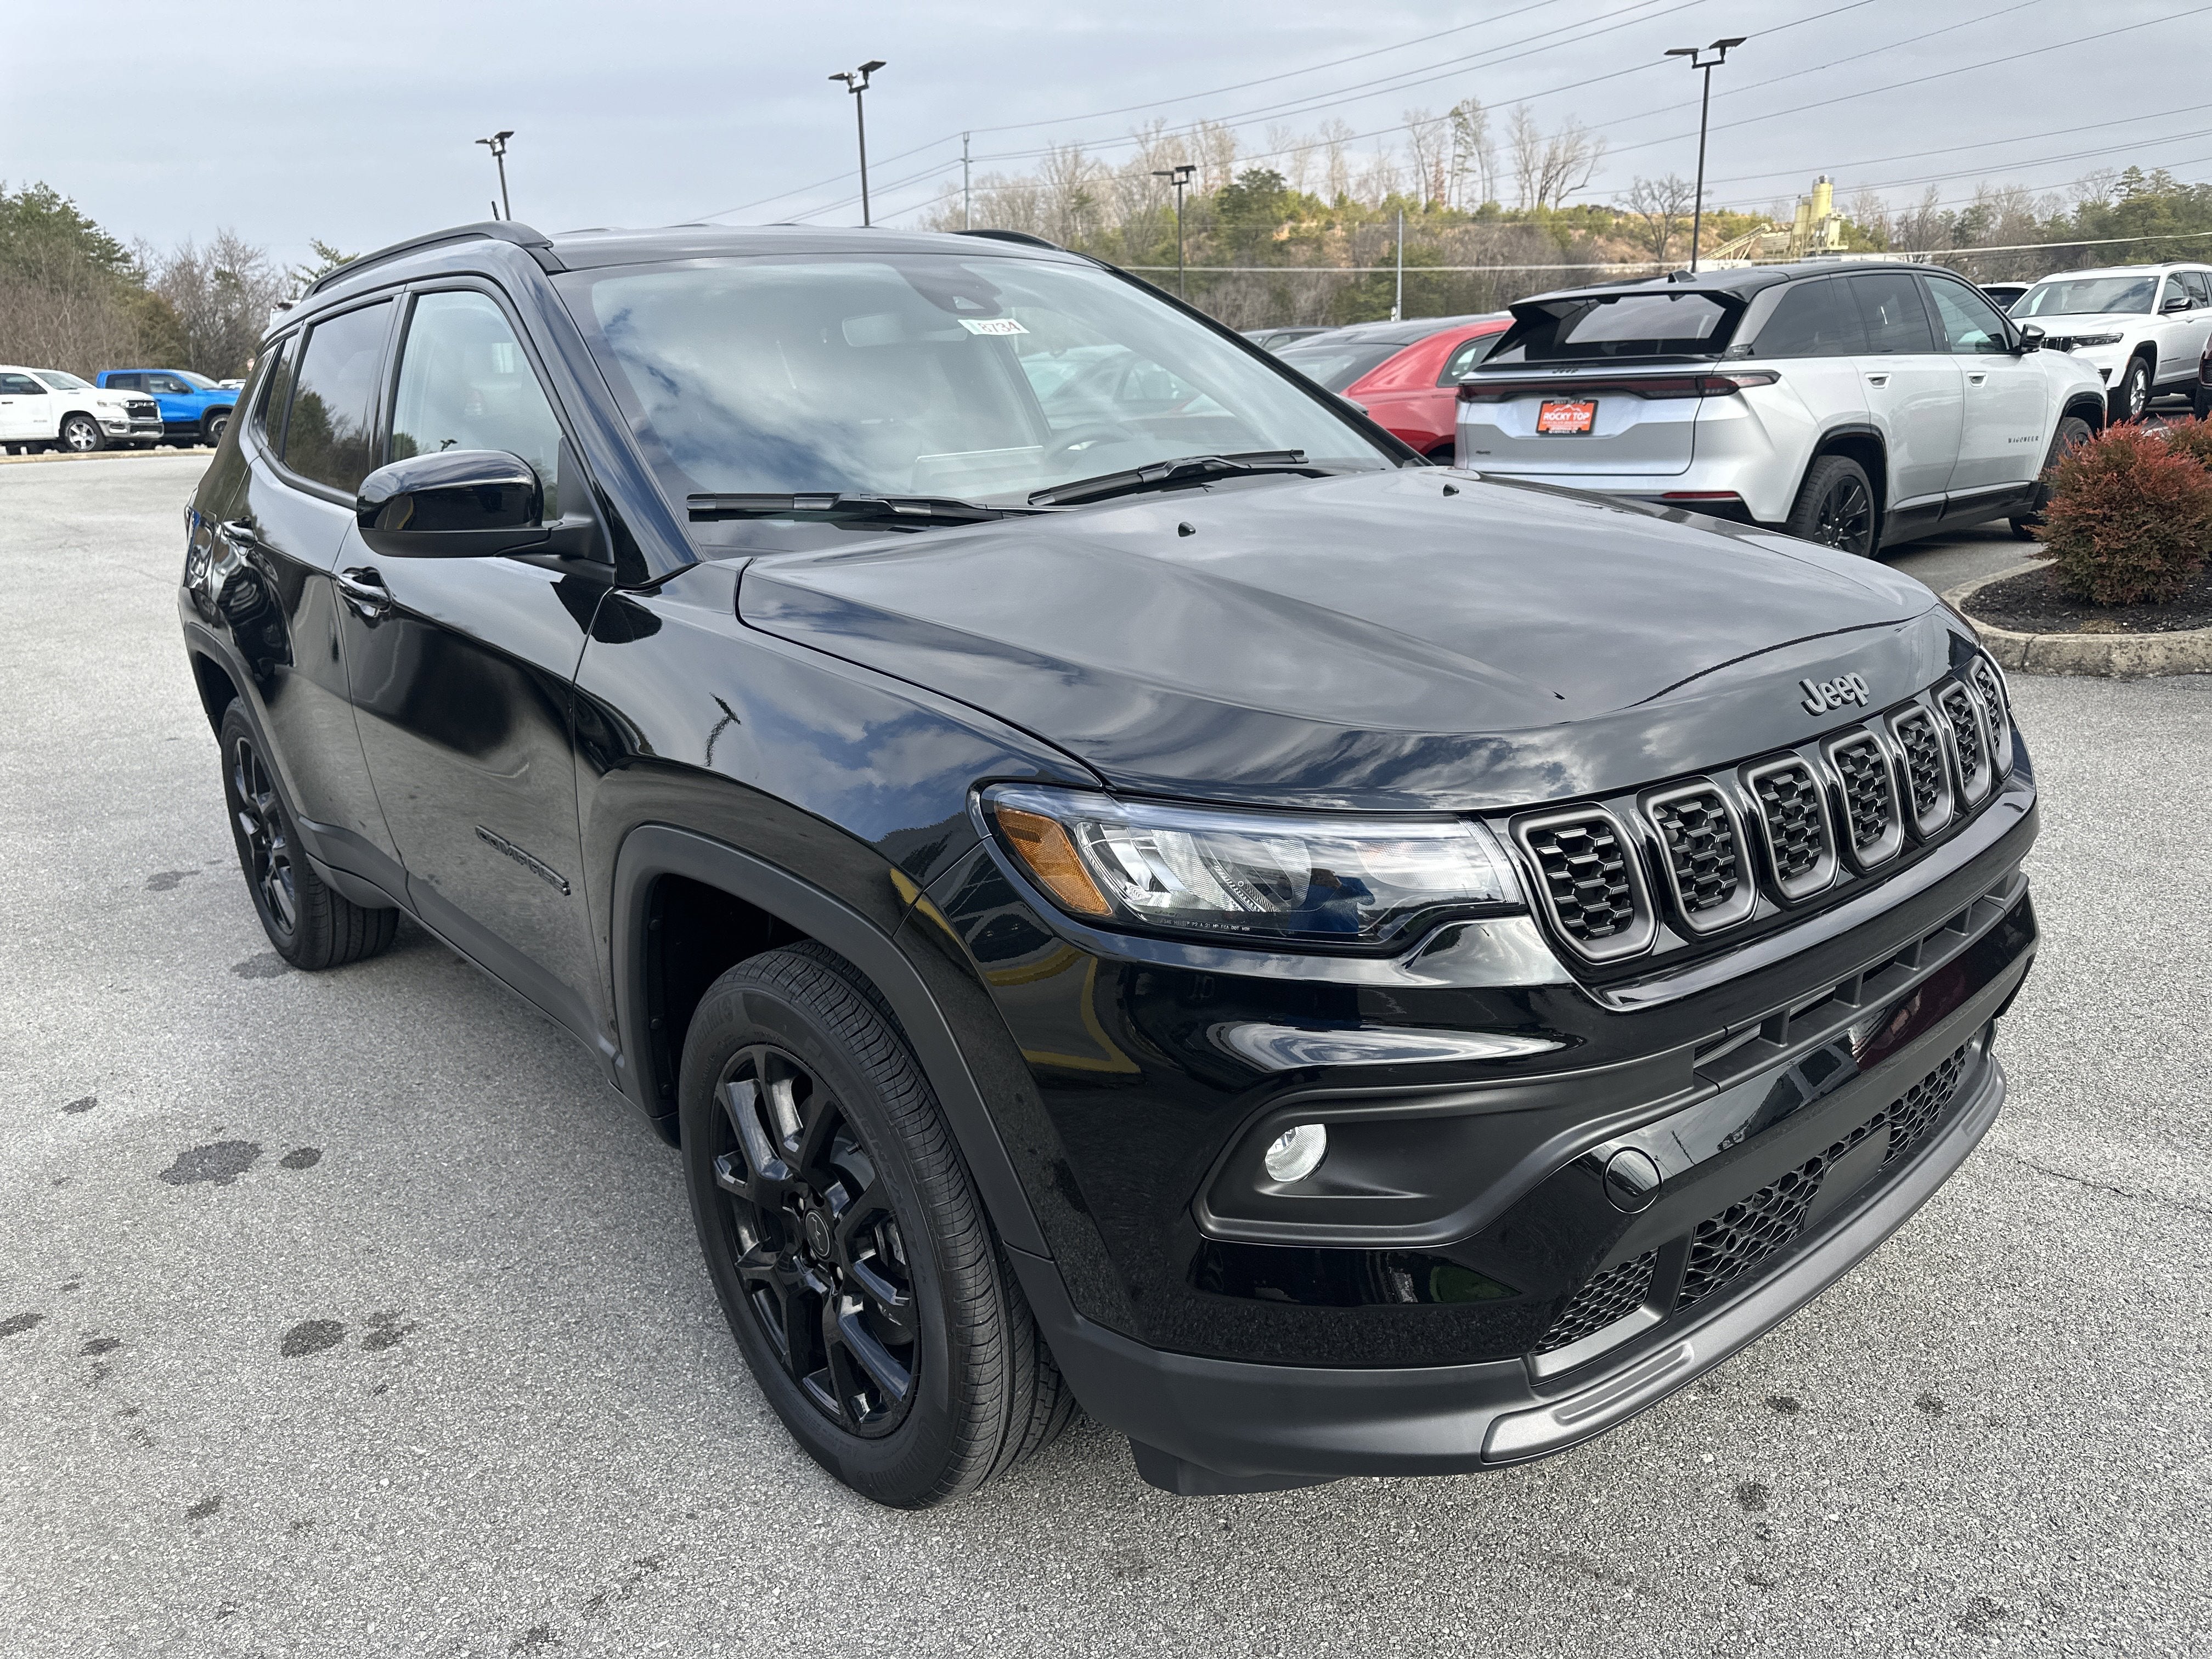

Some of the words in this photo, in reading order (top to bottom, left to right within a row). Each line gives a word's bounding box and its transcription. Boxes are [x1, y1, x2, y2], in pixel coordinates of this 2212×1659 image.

[977, 321, 1021, 333] 8734
[1543, 411, 1572, 421] ROCKY
[1573, 411, 1590, 421] TOP
[1798, 672, 1870, 716] Jeep
